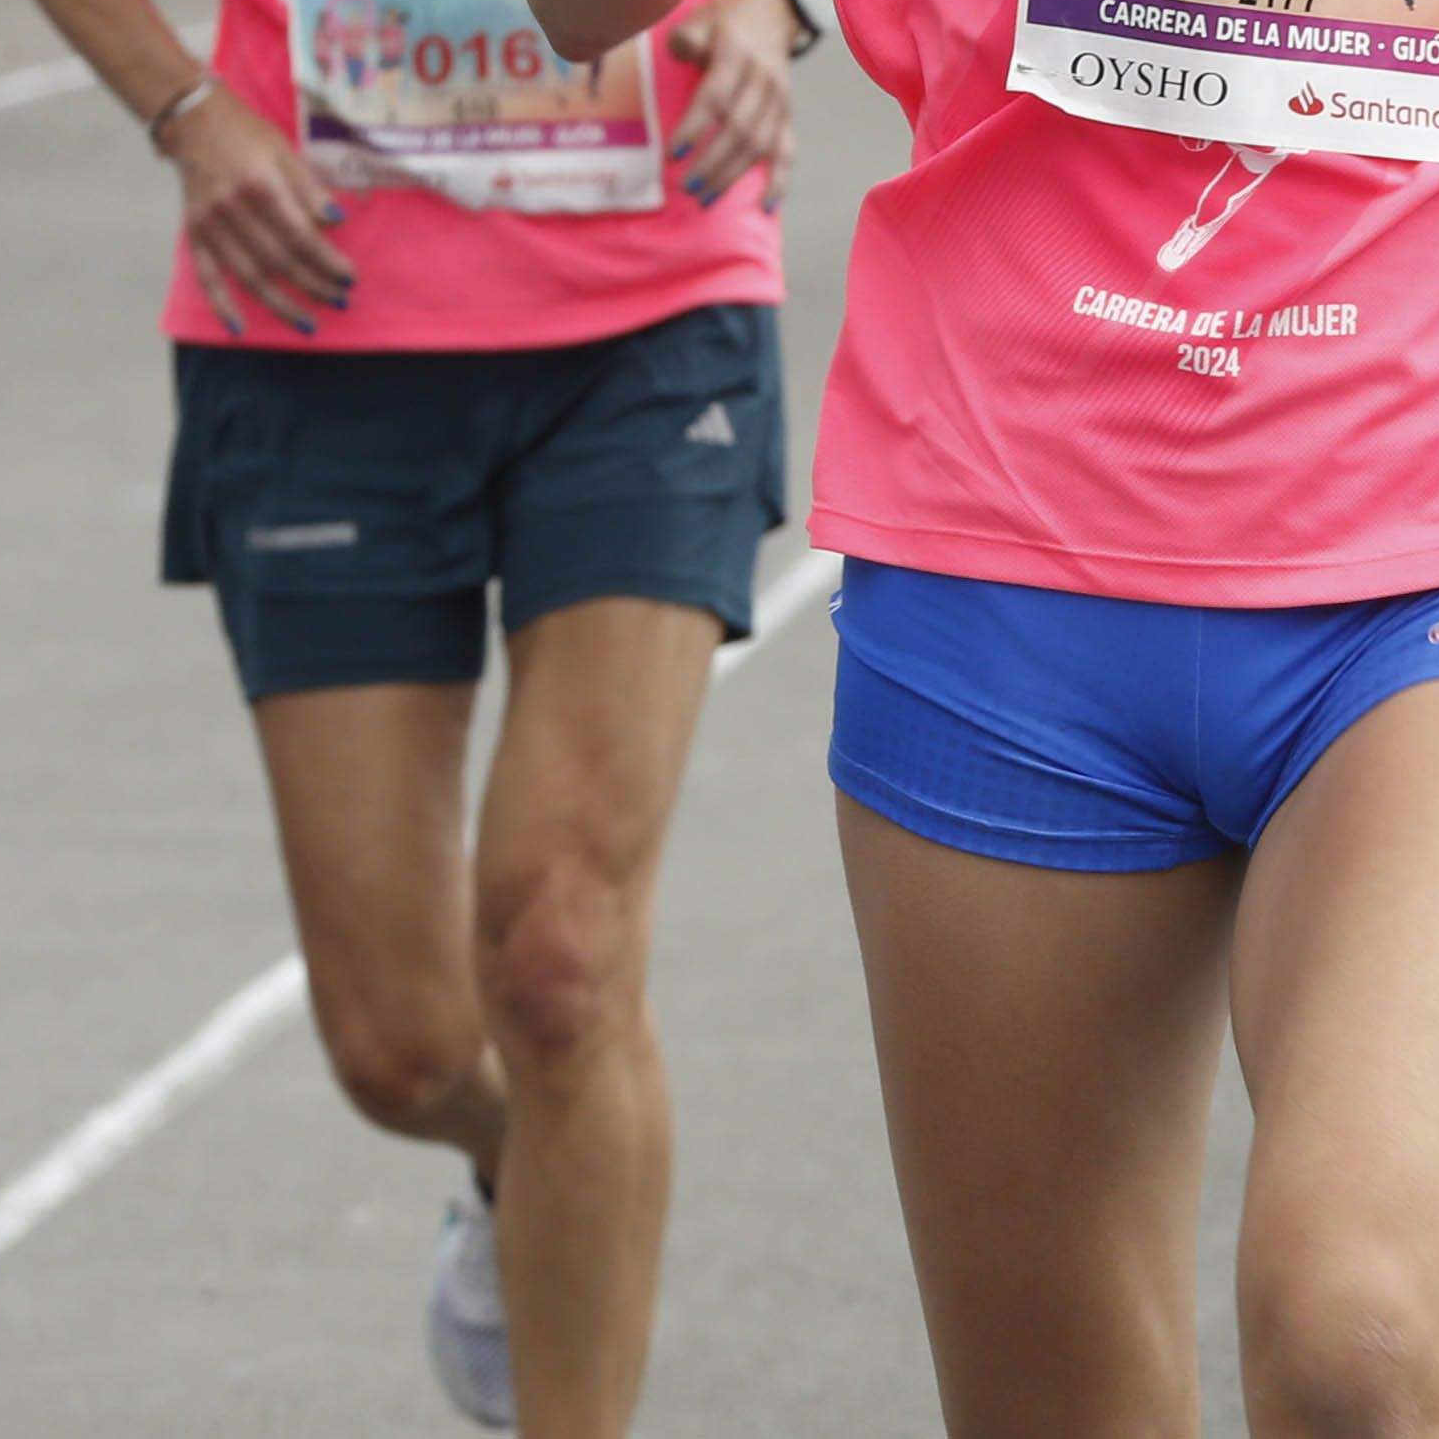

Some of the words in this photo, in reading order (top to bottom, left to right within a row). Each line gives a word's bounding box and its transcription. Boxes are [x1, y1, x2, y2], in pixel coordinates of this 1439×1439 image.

[413, 29, 543, 85] 016
[1216, 17, 1248, 41] DE
[1252, 23, 1281, 46] LA
[1287, 28, 1371, 57] MUJER
[1070, 52, 1228, 107] OYSHO
[1073, 285, 1187, 334] CARRERA
[1191, 310, 1225, 338] DE
[1233, 311, 1263, 338] LA
[1267, 304, 1358, 337] MUJER
[1177, 344, 1242, 377] 2024
